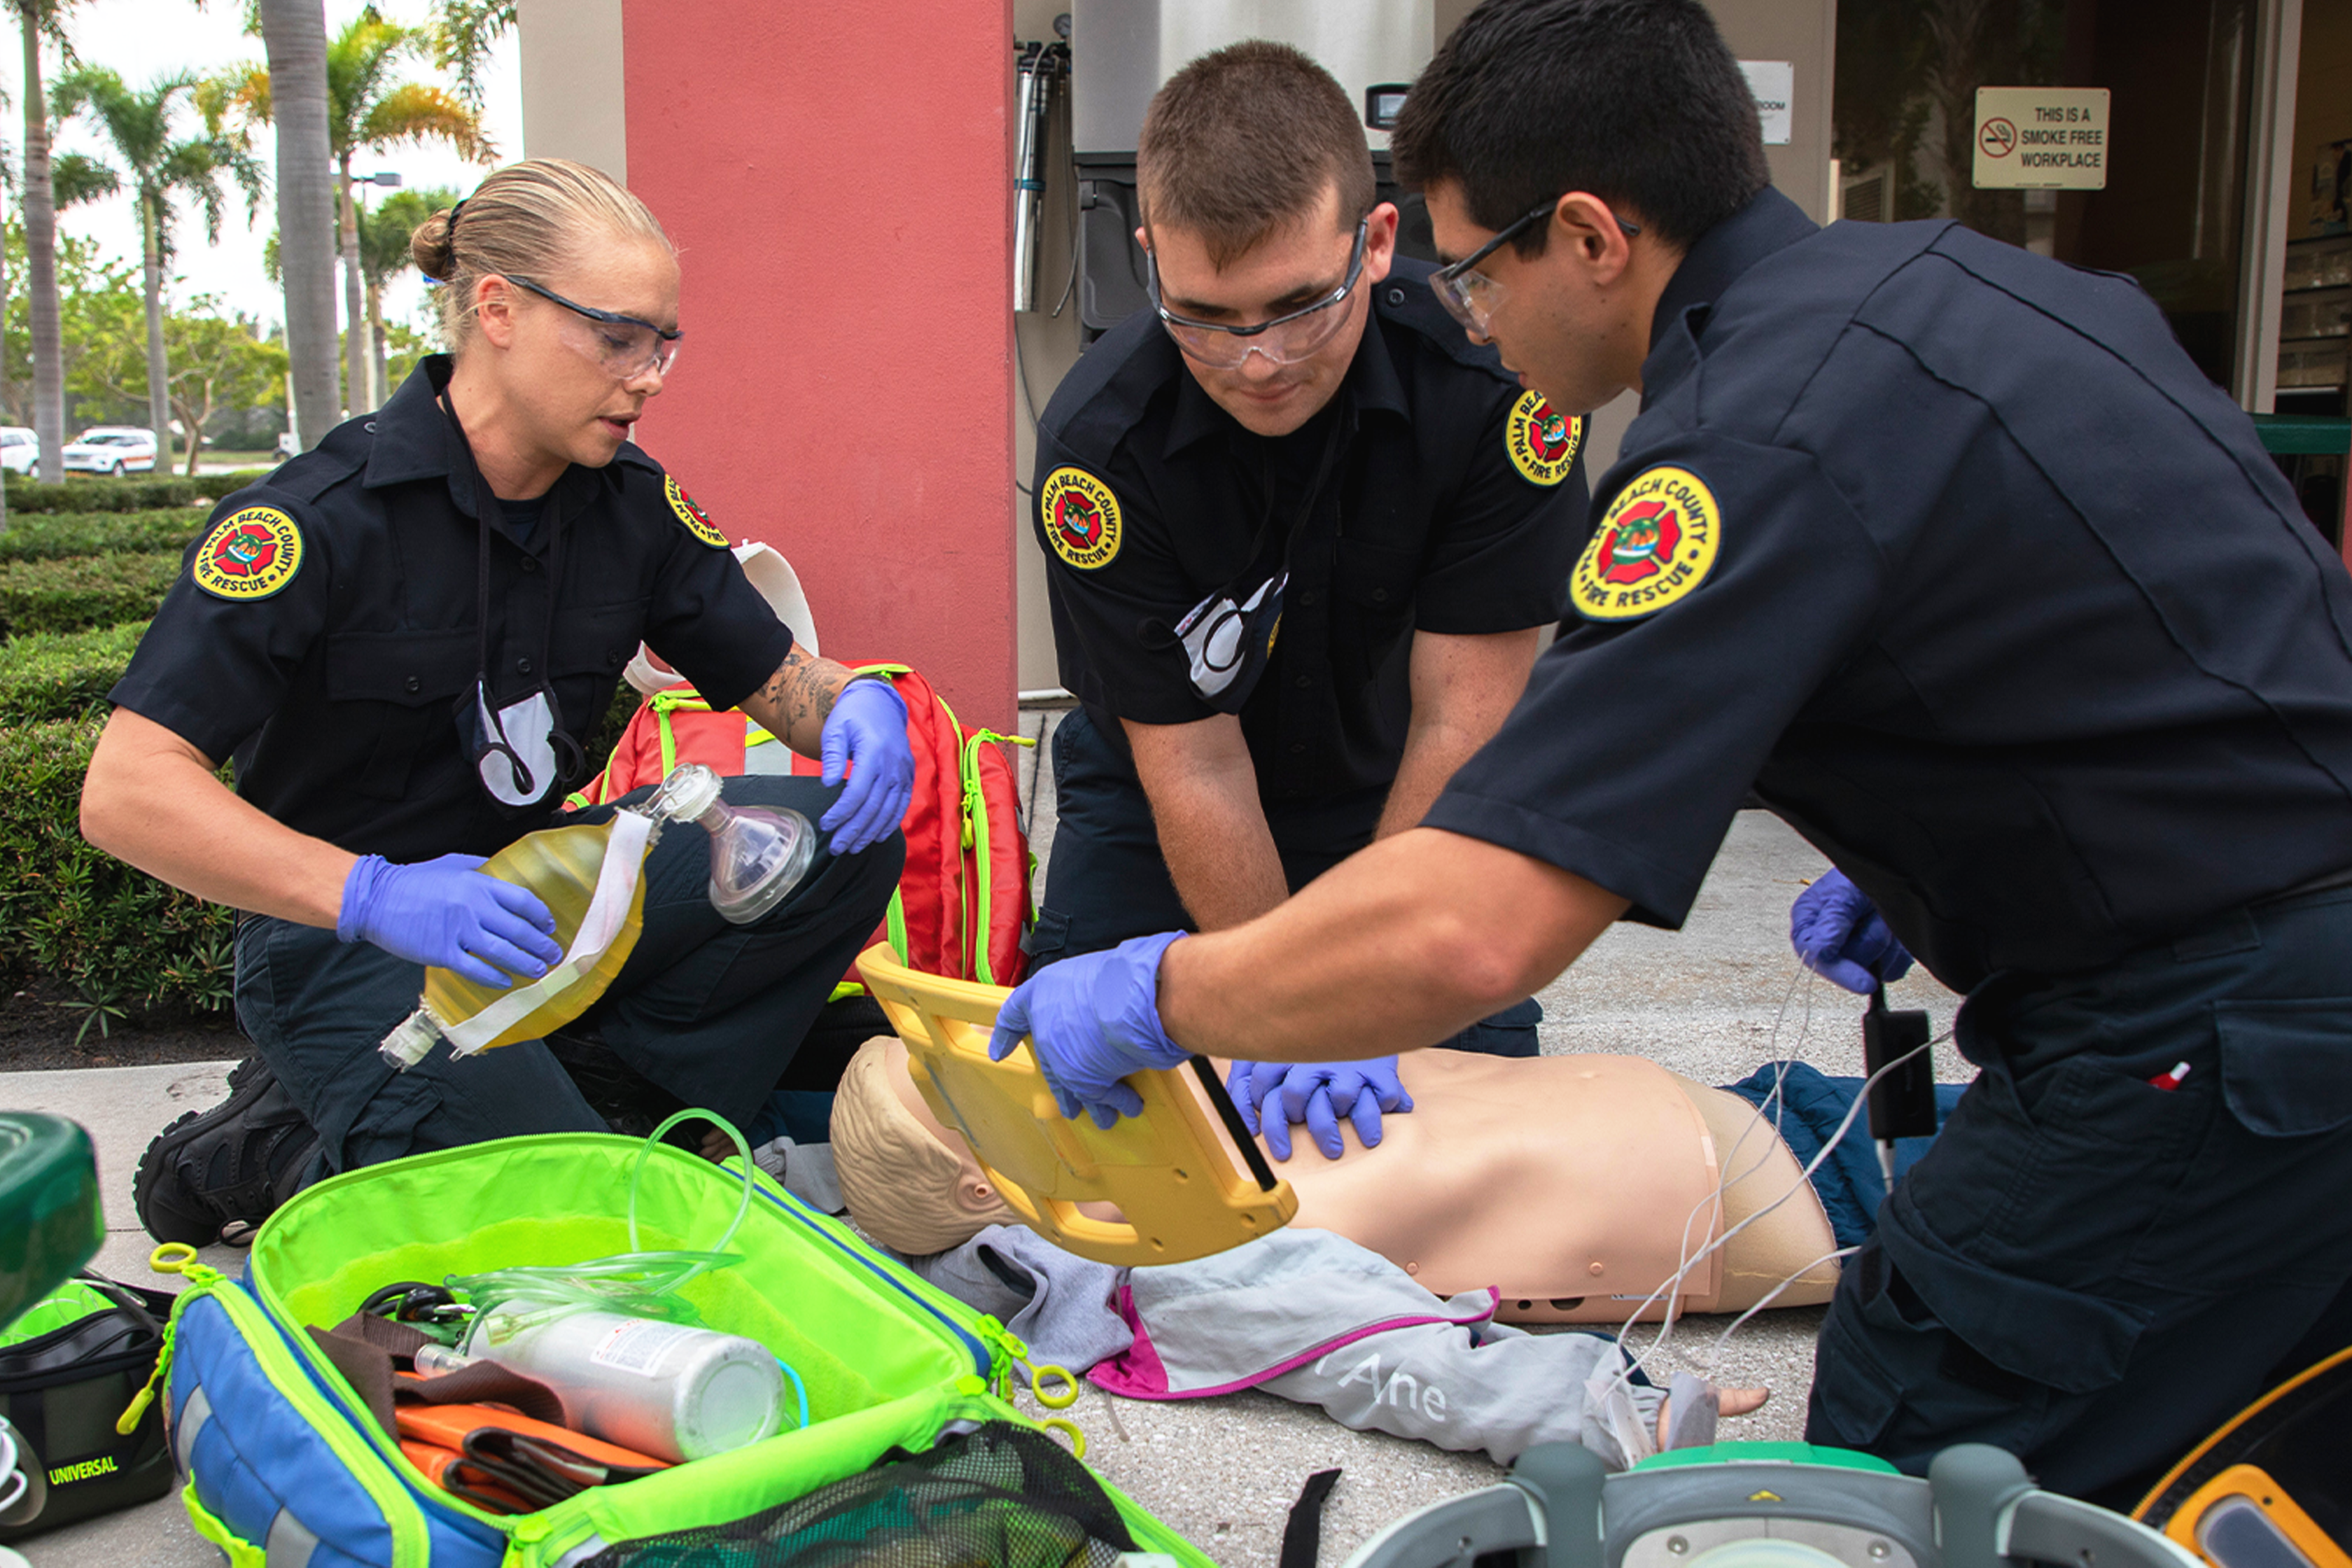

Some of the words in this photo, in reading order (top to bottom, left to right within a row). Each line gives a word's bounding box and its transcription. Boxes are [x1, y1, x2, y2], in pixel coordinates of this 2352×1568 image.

[2035, 106, 2064, 122] THIS
[2066, 106, 2078, 122] IS
[2081, 107, 2091, 122] A
[2021, 129, 2066, 145] SMOKE
[2070, 130, 2103, 145] FREE
[2021, 152, 2101, 167] WORKPLACE
[1513, 417, 1527, 456] PALM
[1520, 391, 1544, 415] BEA
[1527, 460, 1551, 479] FIRE
[1045, 480, 1060, 512] PALM
[1059, 474, 1096, 494] BEACH
[1095, 491, 1116, 542] COUNTY
[1609, 478, 1663, 519] BEACH
[1665, 480, 1708, 544] COUNTY
[205, 520, 234, 548] PALM
[237, 511, 282, 528] BEACH
[275, 526, 295, 576] COUNTY
[1047, 523, 1065, 552] FIRE
[1066, 546, 1109, 564] RESCUE
[211, 575, 269, 592] RESCUE
[1581, 580, 1611, 608] FIRE
[1616, 561, 1694, 608] RESCUE
[50, 1456, 118, 1485] UNIVERSAL
